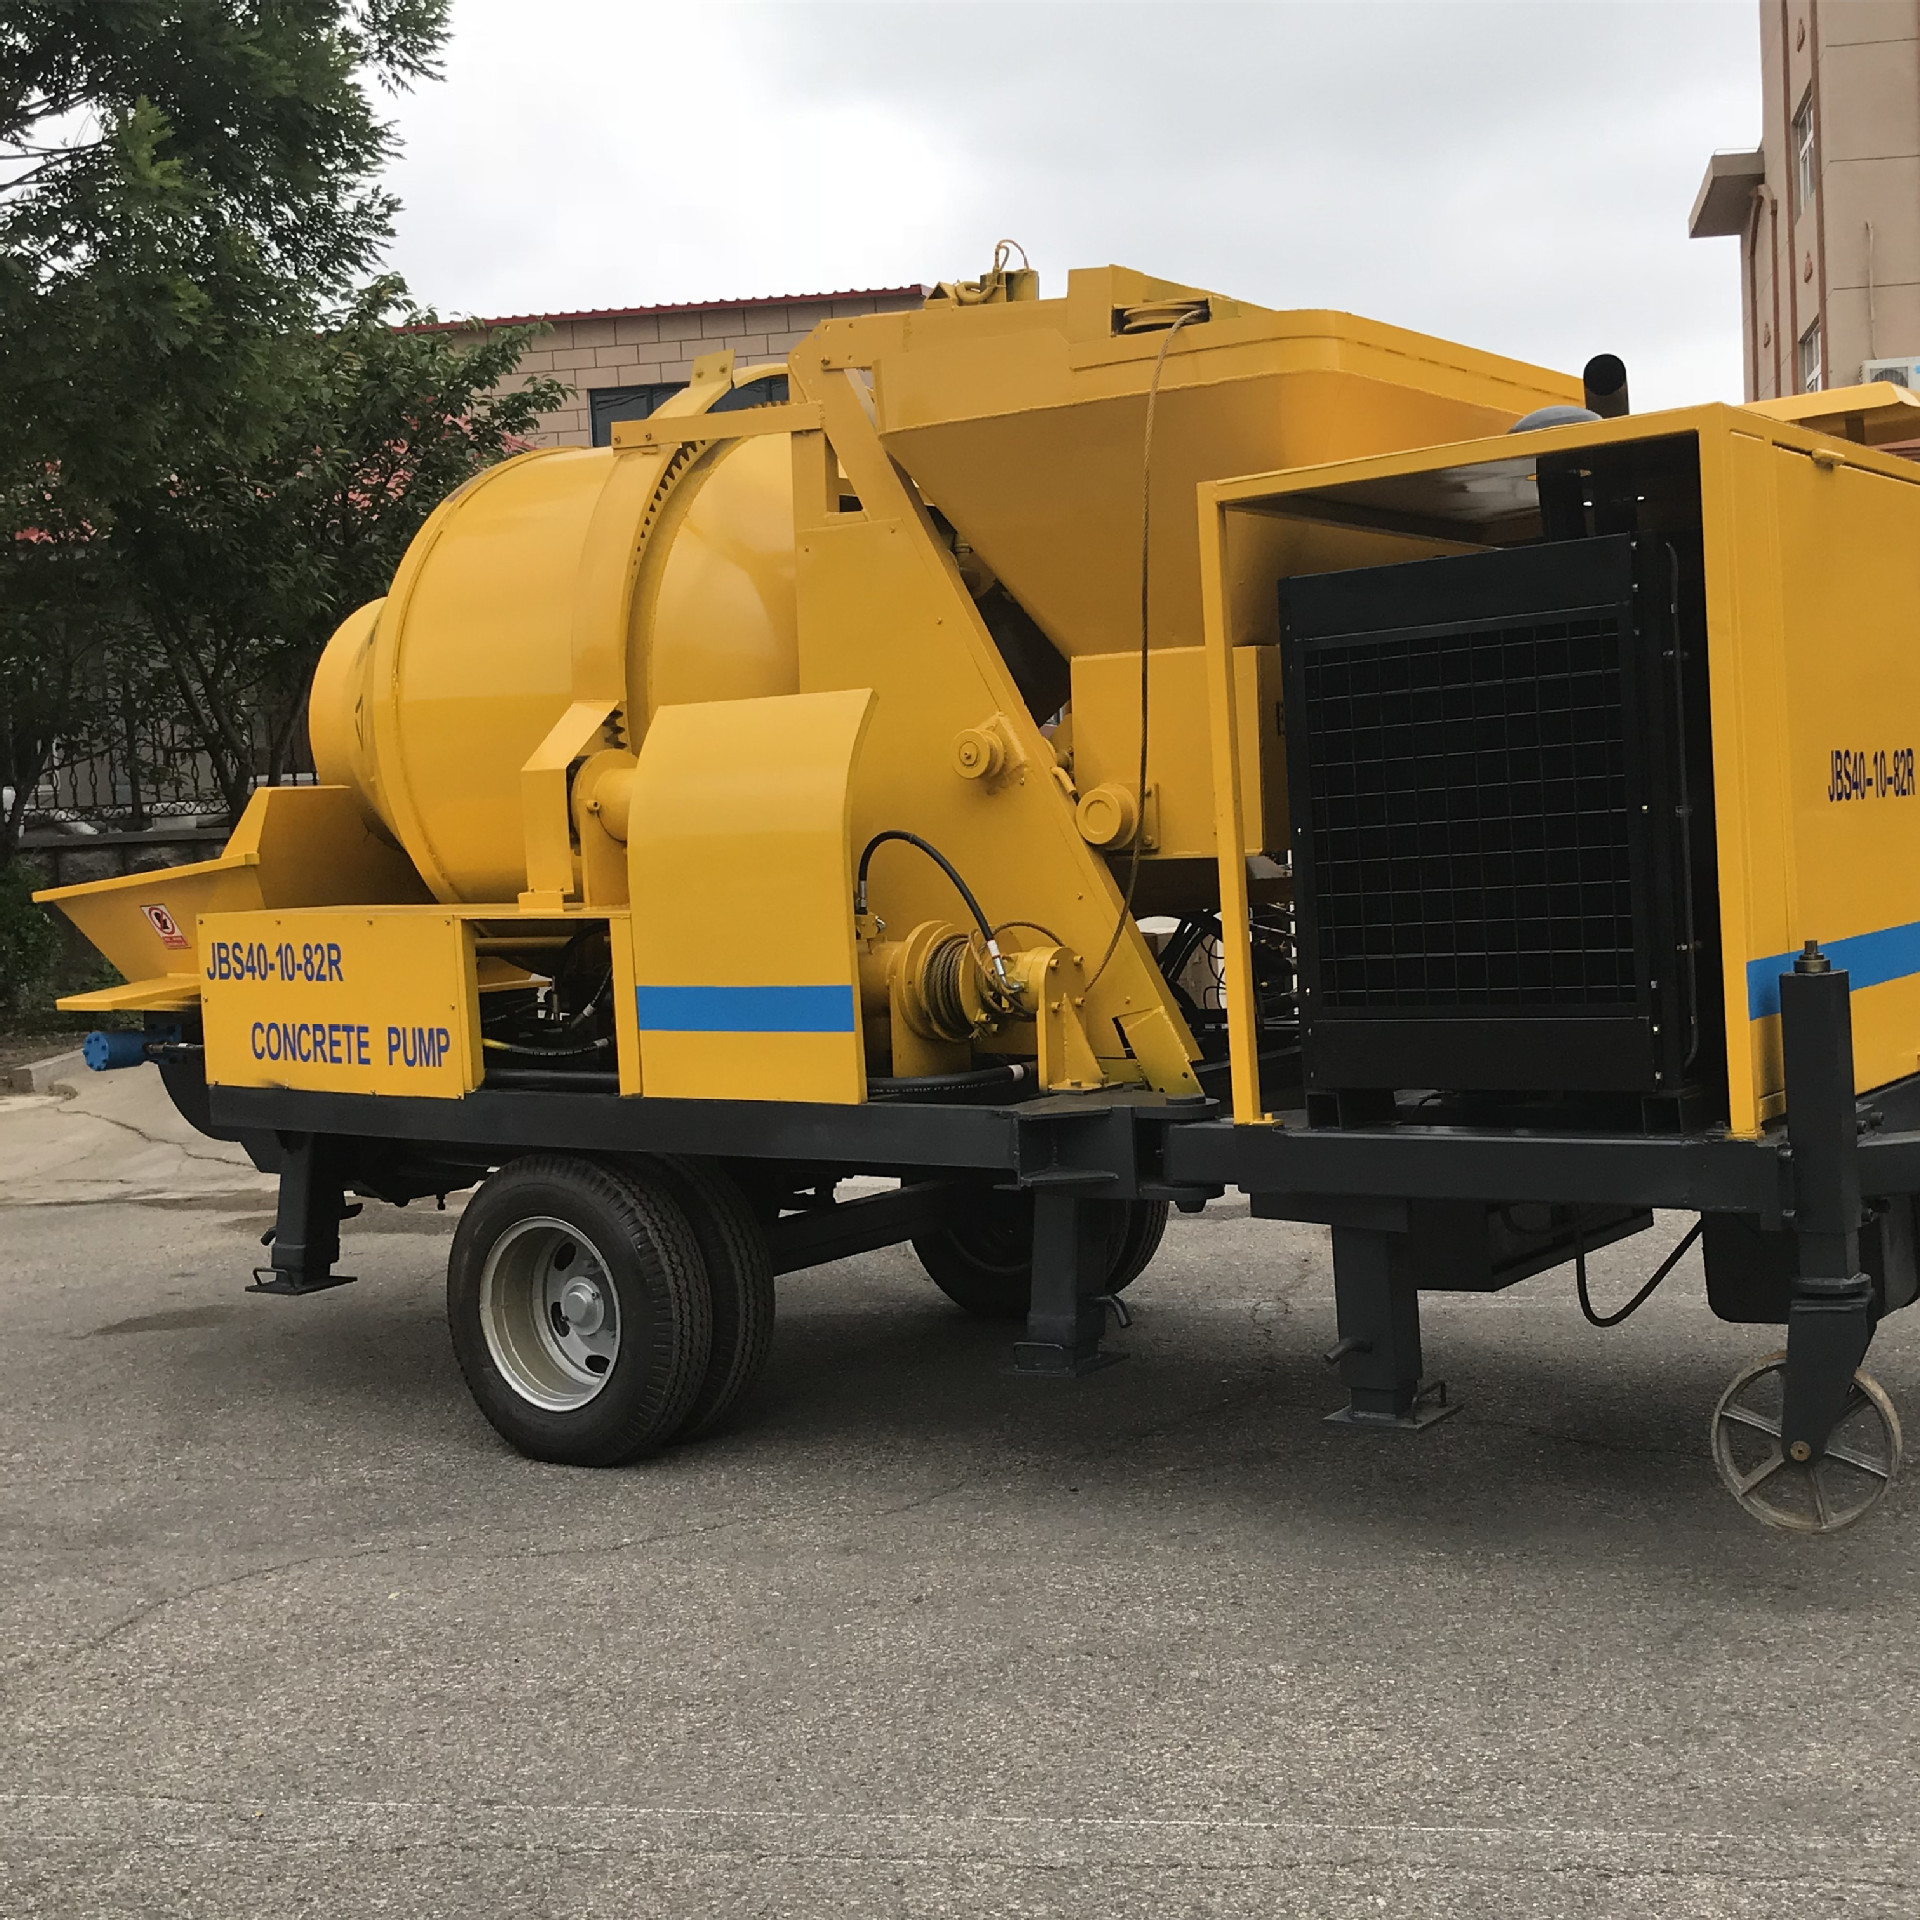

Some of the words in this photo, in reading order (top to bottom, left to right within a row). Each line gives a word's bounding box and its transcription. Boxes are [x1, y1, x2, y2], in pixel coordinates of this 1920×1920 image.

[1828, 748, 1915, 802] JBS40-10-82R
[206, 942, 344, 982] JBS40-10-82R
[251, 1022, 371, 1066] CONCRETE
[387, 1026, 450, 1067] PUMP
